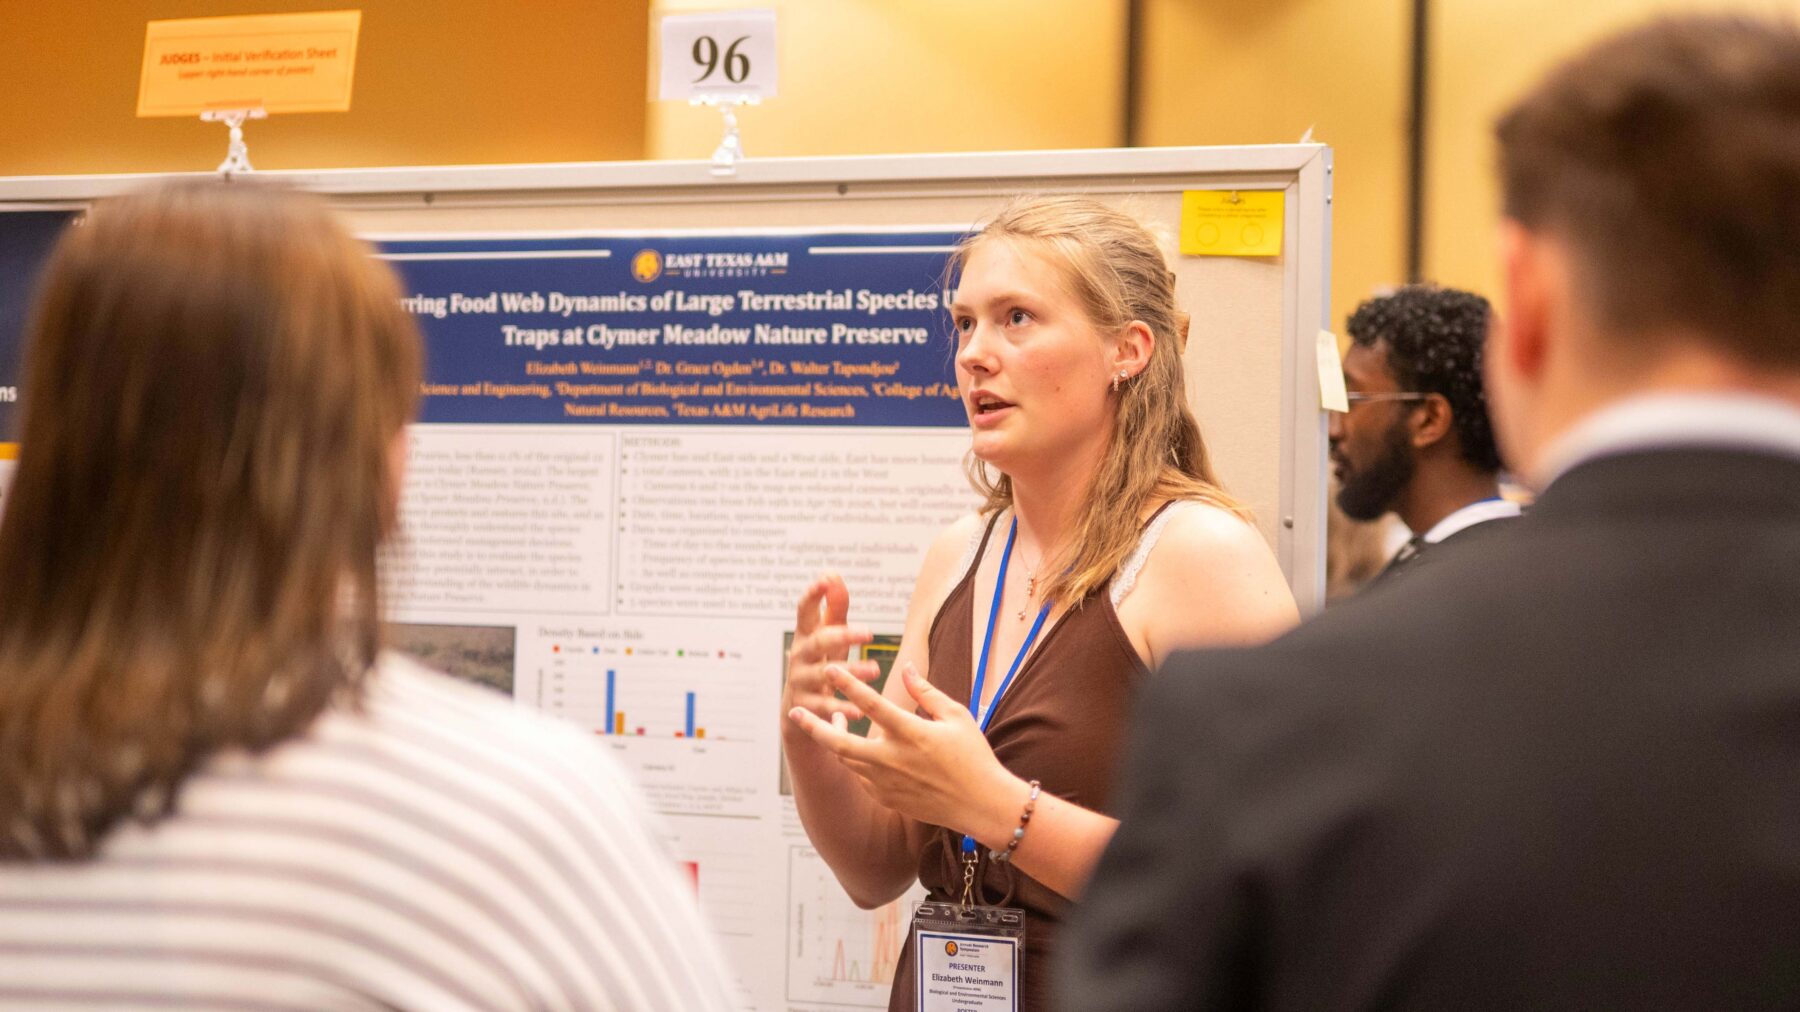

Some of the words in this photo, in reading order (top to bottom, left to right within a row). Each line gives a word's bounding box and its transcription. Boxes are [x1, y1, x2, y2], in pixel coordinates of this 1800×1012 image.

[160, 53, 201, 65] JUDGES
[212, 52, 241, 63] Initial
[244, 48, 304, 61] Verification
[306, 47, 338, 59] Sheet
[691, 35, 752, 83] 96
[664, 253, 703, 268] EAST
[706, 252, 753, 268] TEXAS
[754, 251, 789, 266] A&M
[684, 267, 768, 278] UNIVERSITY
[400, 293, 448, 318] rring
[450, 292, 497, 313] Food
[501, 292, 545, 313] Web
[548, 291, 647, 317] Dynamics
[650, 290, 674, 312] of
[676, 290, 735, 316] Large
[737, 288, 853, 311] Terrestrial
[855, 288, 939, 315] Species
[501, 325, 560, 350] Traps
[563, 326, 584, 345] at
[586, 323, 661, 350] Clymer
[663, 324, 751, 346] Meadow
[754, 323, 828, 345] Nature
[831, 323, 929, 345] Preserve
[526, 361, 578, 376] Elizabeth
[655, 361, 672, 376] Dr.
[675, 361, 710, 376] Grace
[769, 361, 787, 376] Dr.
[790, 360, 830, 376] Walter
[461, 381, 482, 396] and
[484, 381, 552, 399] Engineering,
[626, 382, 640, 396] of
[641, 381, 699, 399] Biological
[702, 382, 723, 397] and
[725, 382, 811, 397] Environmental
[814, 382, 869, 399] Sciences,
[924, 382, 940, 397] of
[563, 402, 606, 417] Natural
[608, 402, 670, 418] Resources,
[712, 402, 746, 417] A&M
[748, 402, 798, 420] AgriLife
[800, 403, 855, 418] Research
[948, 963, 986, 973] PRESENTER
[932, 973, 963, 983] Elizabeth
[964, 976, 1004, 987] Weinmann
[952, 998, 983, 1006] Undergraduate
[958, 991, 988, 999] Environmental
